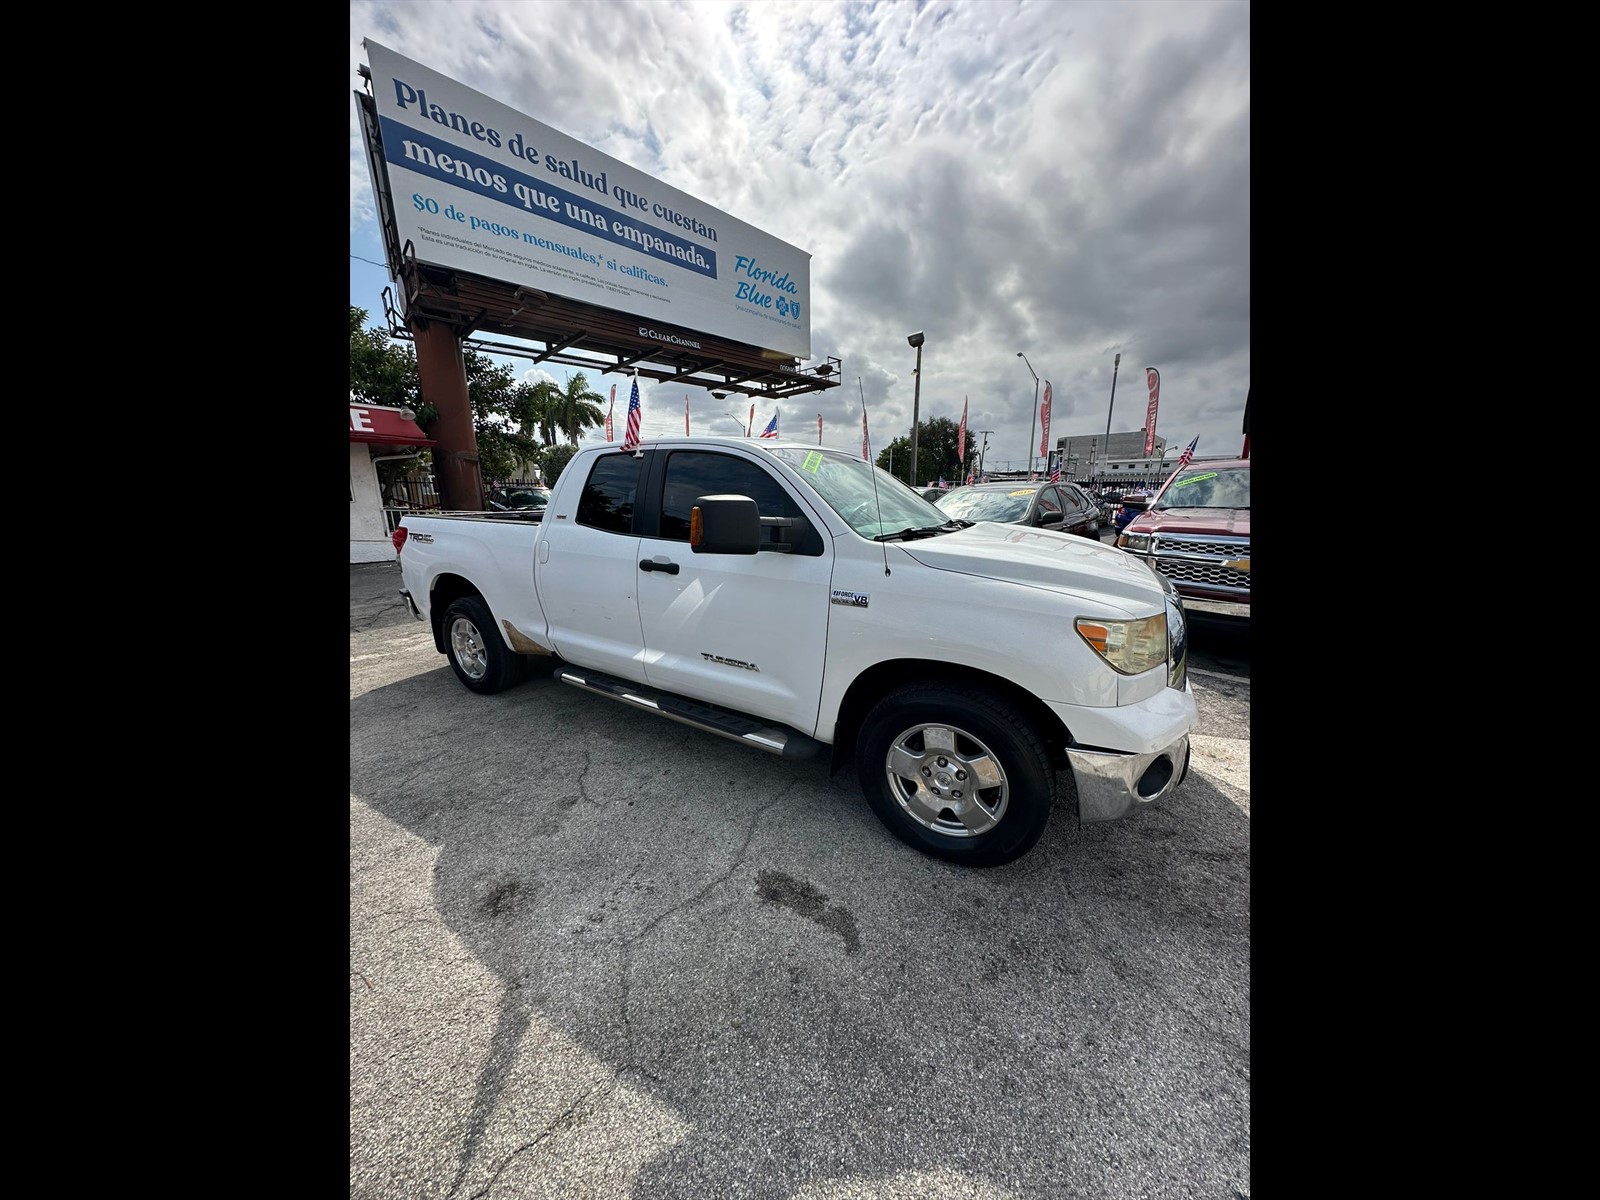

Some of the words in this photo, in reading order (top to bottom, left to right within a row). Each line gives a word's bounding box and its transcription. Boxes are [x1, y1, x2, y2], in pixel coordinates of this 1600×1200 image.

[392, 78, 501, 148] Planes
[508, 134, 539, 164] de
[545, 154, 608, 195] salud
[613, 185, 649, 212] que
[652, 203, 718, 242] cuestan
[402, 140, 508, 193] menos
[513, 182, 561, 213] que
[565, 202, 608, 231] una
[612, 221, 711, 270] empanada.
[412, 193, 439, 214] $0
[444, 205, 466, 222] de
[469, 215, 519, 240] pagos
[607, 259, 617, 272] si
[620, 264, 668, 287] calificas.
[735, 255, 797, 294] Florida
[735, 282, 772, 308] Blue
[854, 595, 867, 605] V8
[701, 653, 760, 672] TUNDRA
